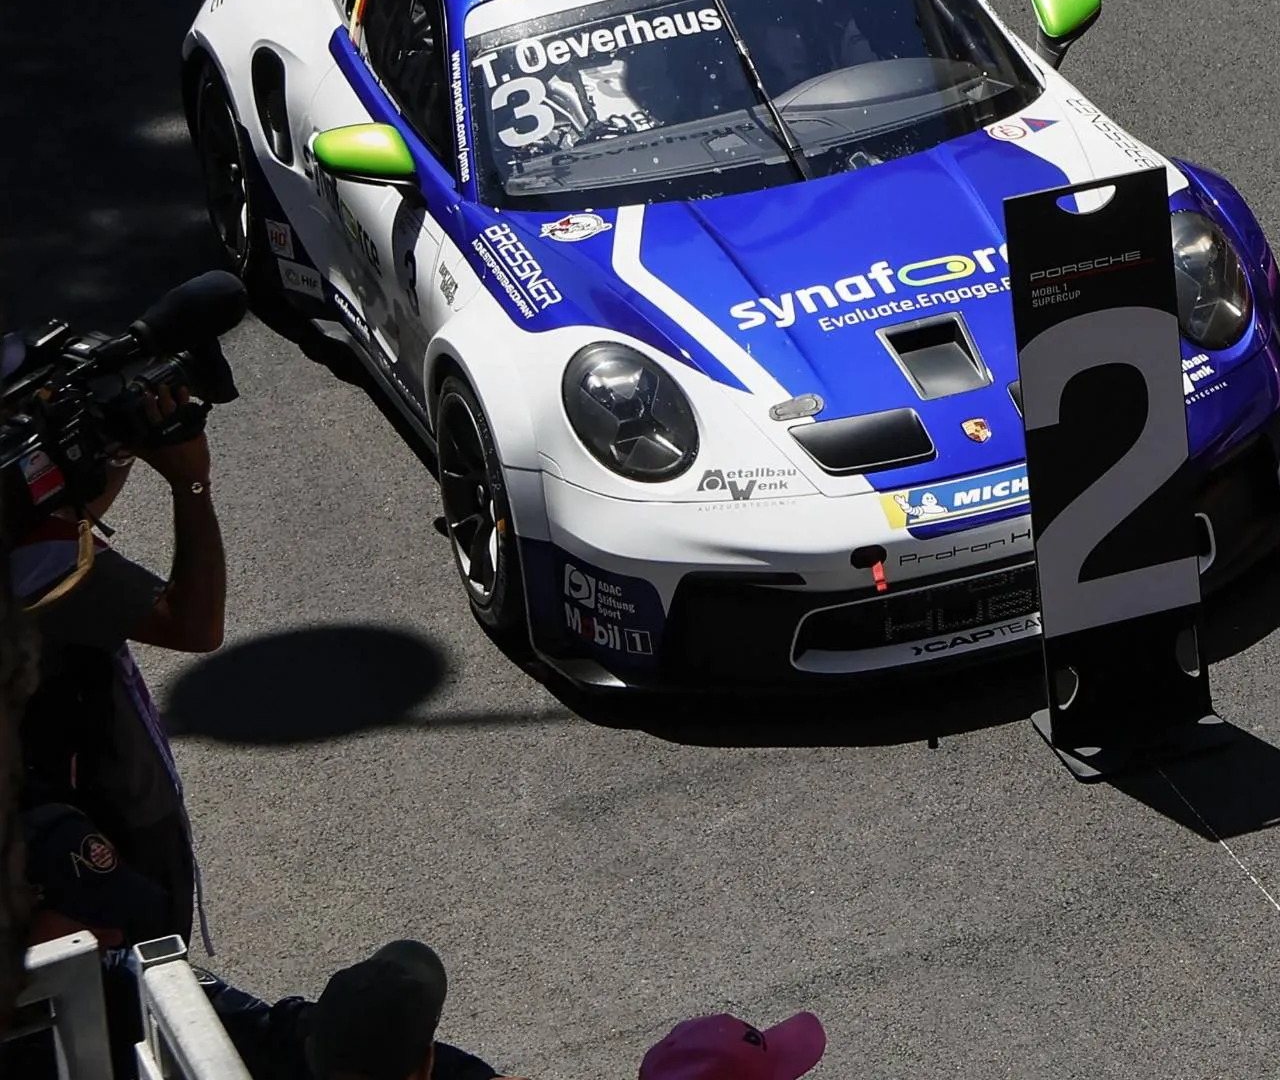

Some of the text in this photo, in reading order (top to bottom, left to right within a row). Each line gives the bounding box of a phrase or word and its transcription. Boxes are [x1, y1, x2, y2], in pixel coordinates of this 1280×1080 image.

[471, 8, 723, 89] T. Oeverhaus
[450, 49, 470, 184] www.porsche.com/pmsc
[491, 76, 555, 149] 3
[484, 223, 563, 310] BRESSNER
[1030, 250, 1142, 282] PORSCHE
[1031, 285, 1062, 299] MOBIL
[1031, 290, 1082, 308] SUPERCUP
[696, 467, 797, 492] Metallbau
[1019, 306, 1201, 639] 2
[727, 479, 788, 501] Wenk
[597, 592, 636, 613] Stiftung
[598, 581, 622, 597] ADAC
[597, 603, 622, 620] Sport
[564, 601, 643, 652] Mobil 1
